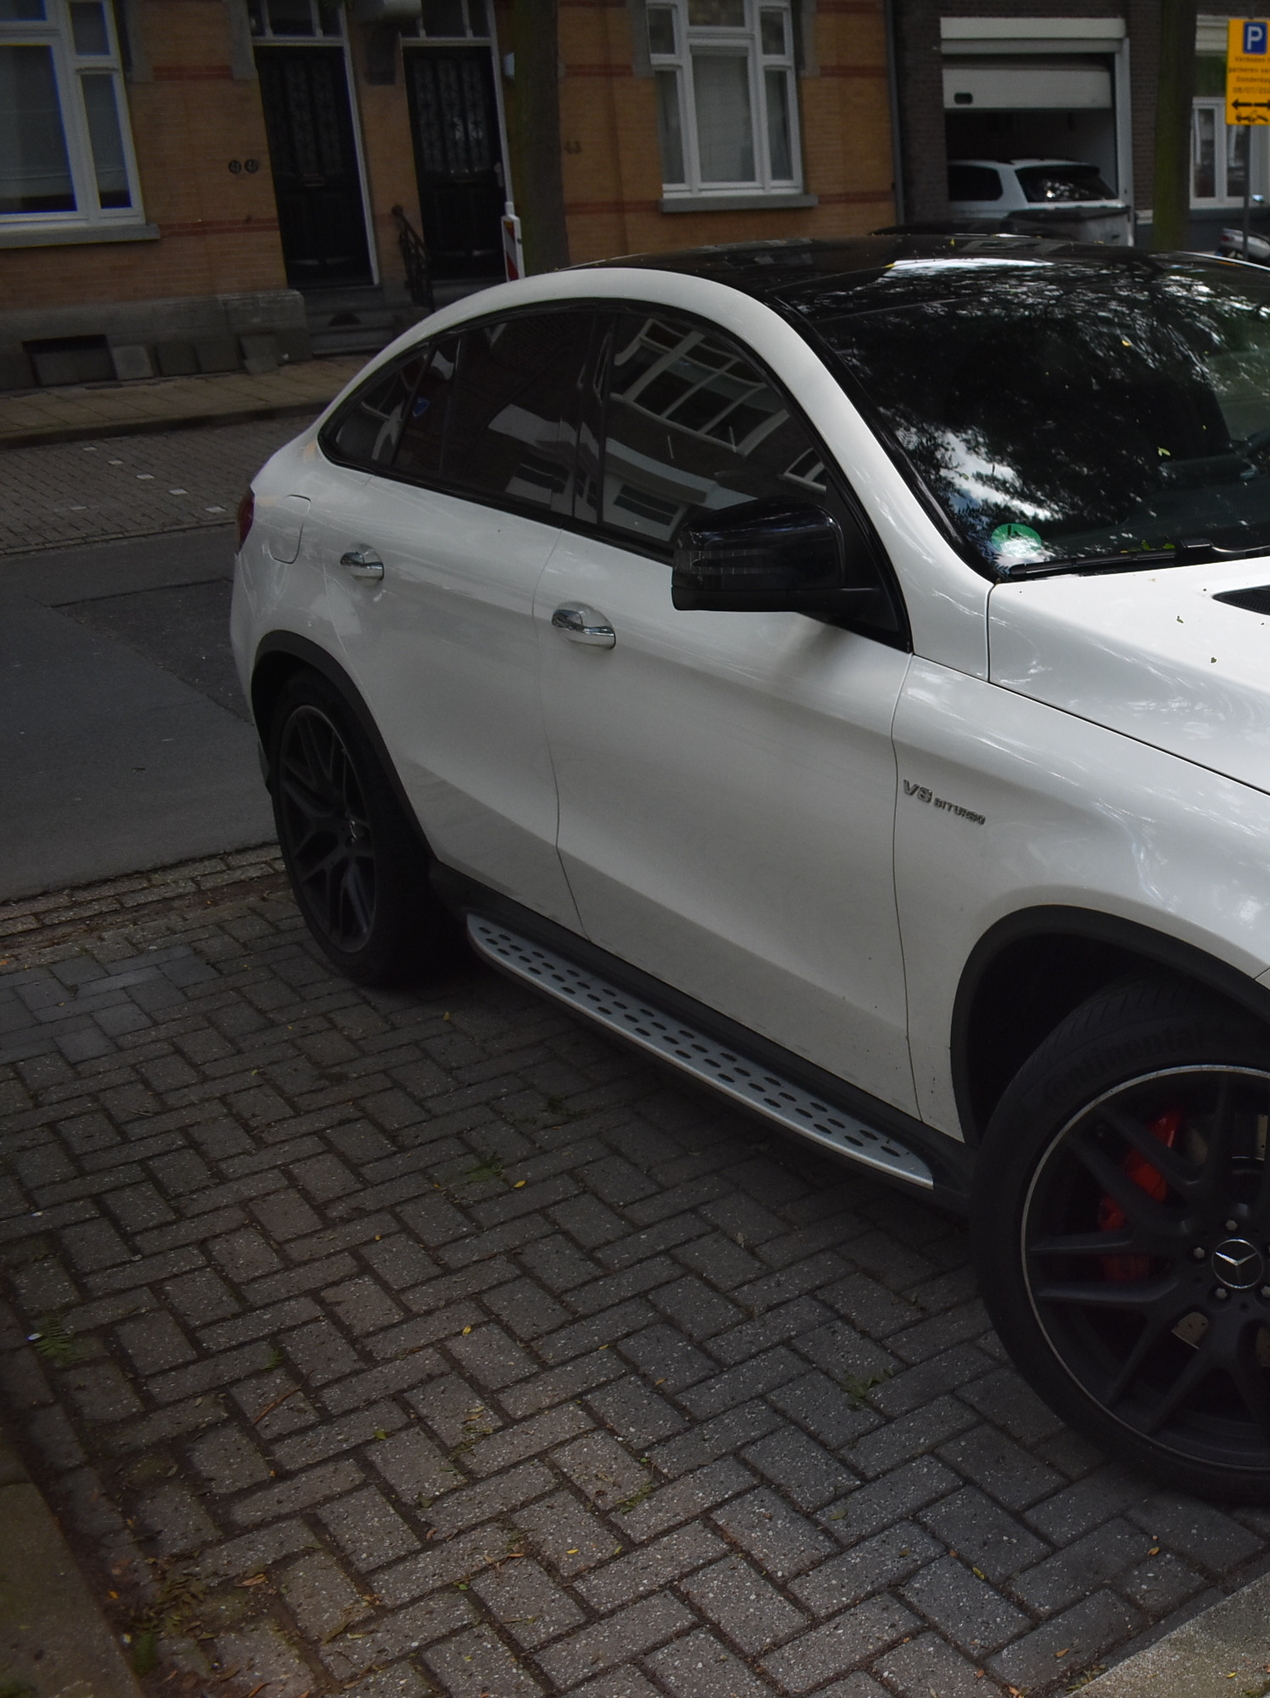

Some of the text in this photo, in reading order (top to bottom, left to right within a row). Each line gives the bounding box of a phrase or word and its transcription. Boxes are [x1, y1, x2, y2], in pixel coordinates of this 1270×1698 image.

[1247, 26, 1263, 50] P
[903, 779, 986, 826] V8 BITURBO
